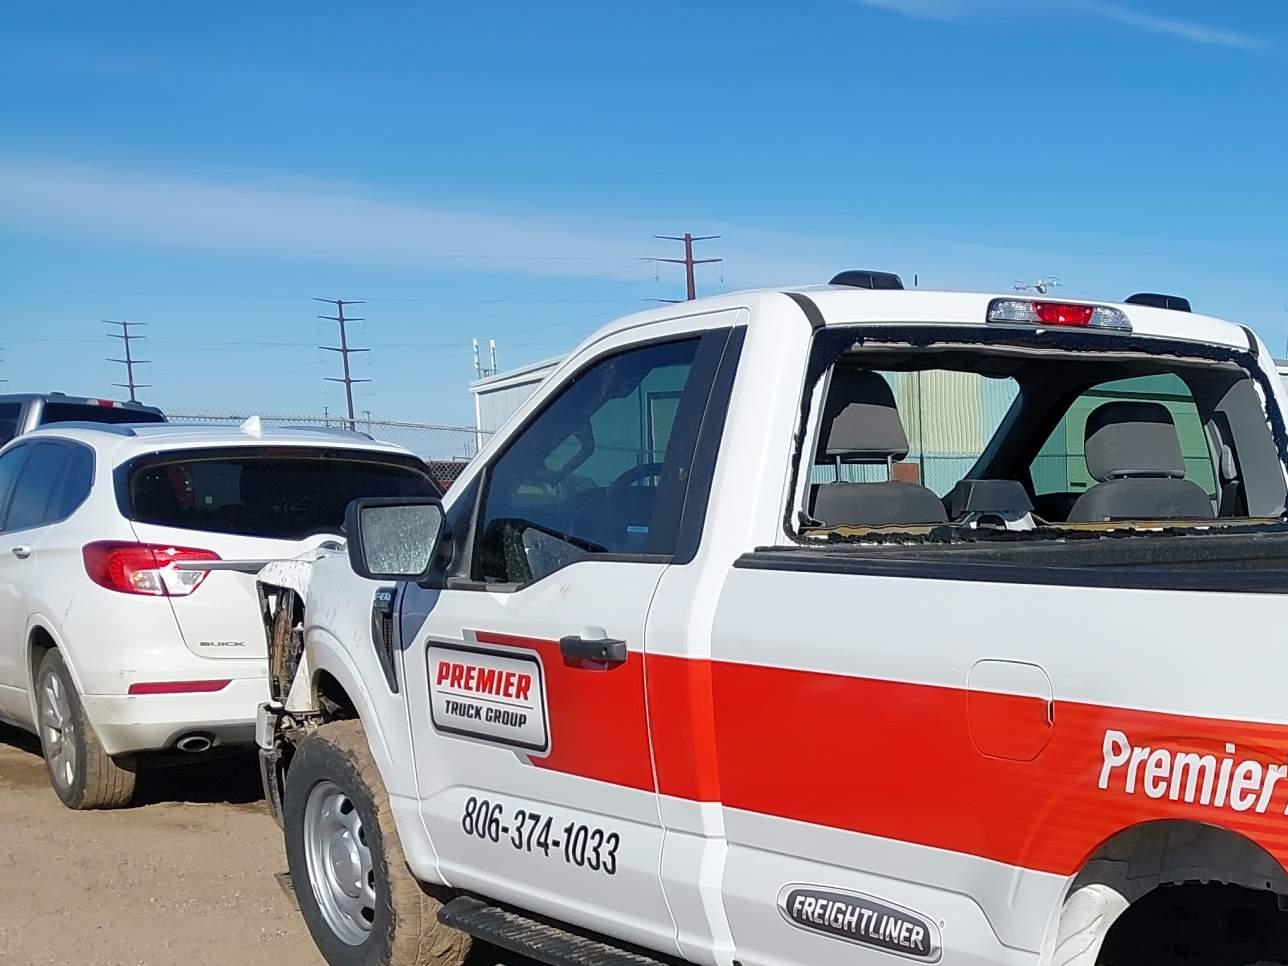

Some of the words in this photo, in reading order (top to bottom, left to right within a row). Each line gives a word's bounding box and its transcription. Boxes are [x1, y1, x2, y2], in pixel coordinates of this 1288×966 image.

[436, 661, 531, 700] PREMIER
[445, 700, 482, 721] TRUCK
[485, 708, 527, 728] GROUP
[461, 796, 620, 875] 806-374-1033
[792, 895, 924, 951] FREIGHTLINER
